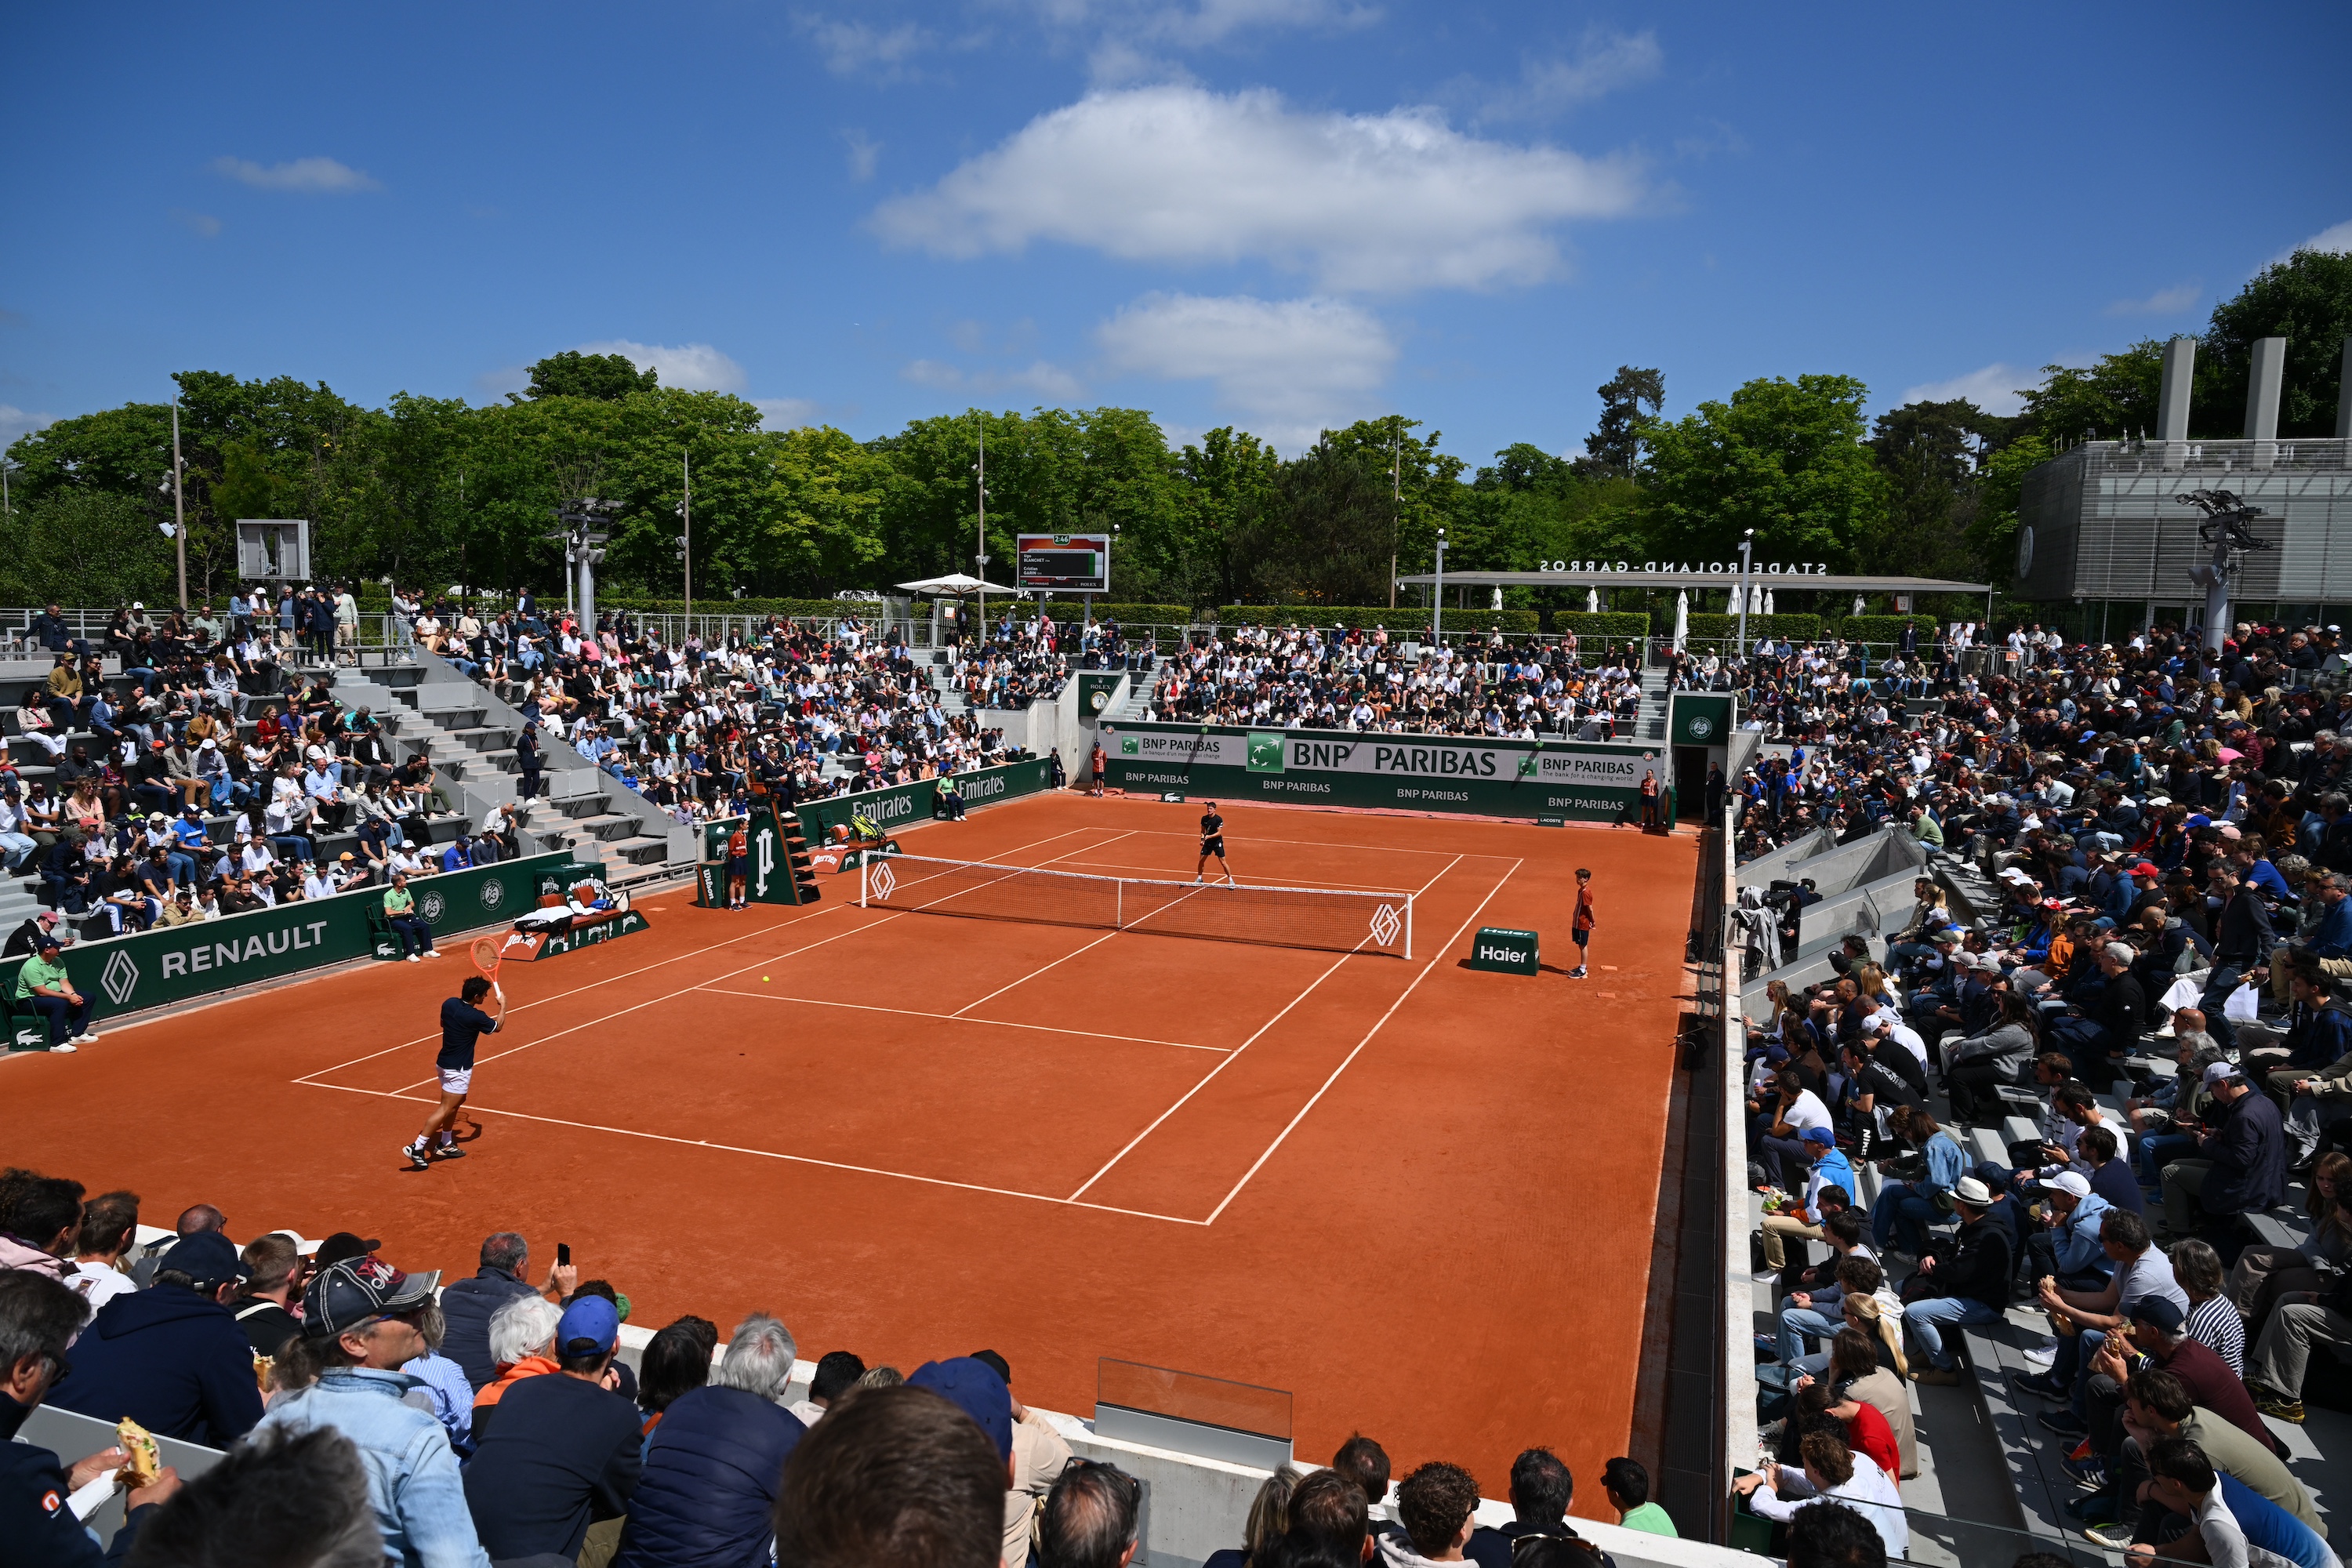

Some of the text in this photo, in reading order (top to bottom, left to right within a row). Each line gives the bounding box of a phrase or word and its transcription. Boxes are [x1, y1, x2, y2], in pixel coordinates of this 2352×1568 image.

[1142, 738, 1220, 753] BNP PARIBAS
[1294, 742, 1496, 776] BNP PARIBAS
[1543, 758, 1634, 775] BNP PARIBAS
[1125, 772, 1189, 785] BNP PARIBAS
[1263, 780, 1330, 793] BNP PARIBAS
[958, 775, 1004, 801] Emirates
[1397, 788, 1468, 801] BNP PARIBAS
[852, 794, 913, 822] Emirates
[1548, 797, 1624, 811] BNP PARIBAS
[703, 868, 714, 900] Wilson
[524, 920, 549, 928] HEA
[162, 920, 328, 979] RENAULT
[1480, 946, 1527, 964] Haier
[1861, 1129, 1871, 1156] NIKE
